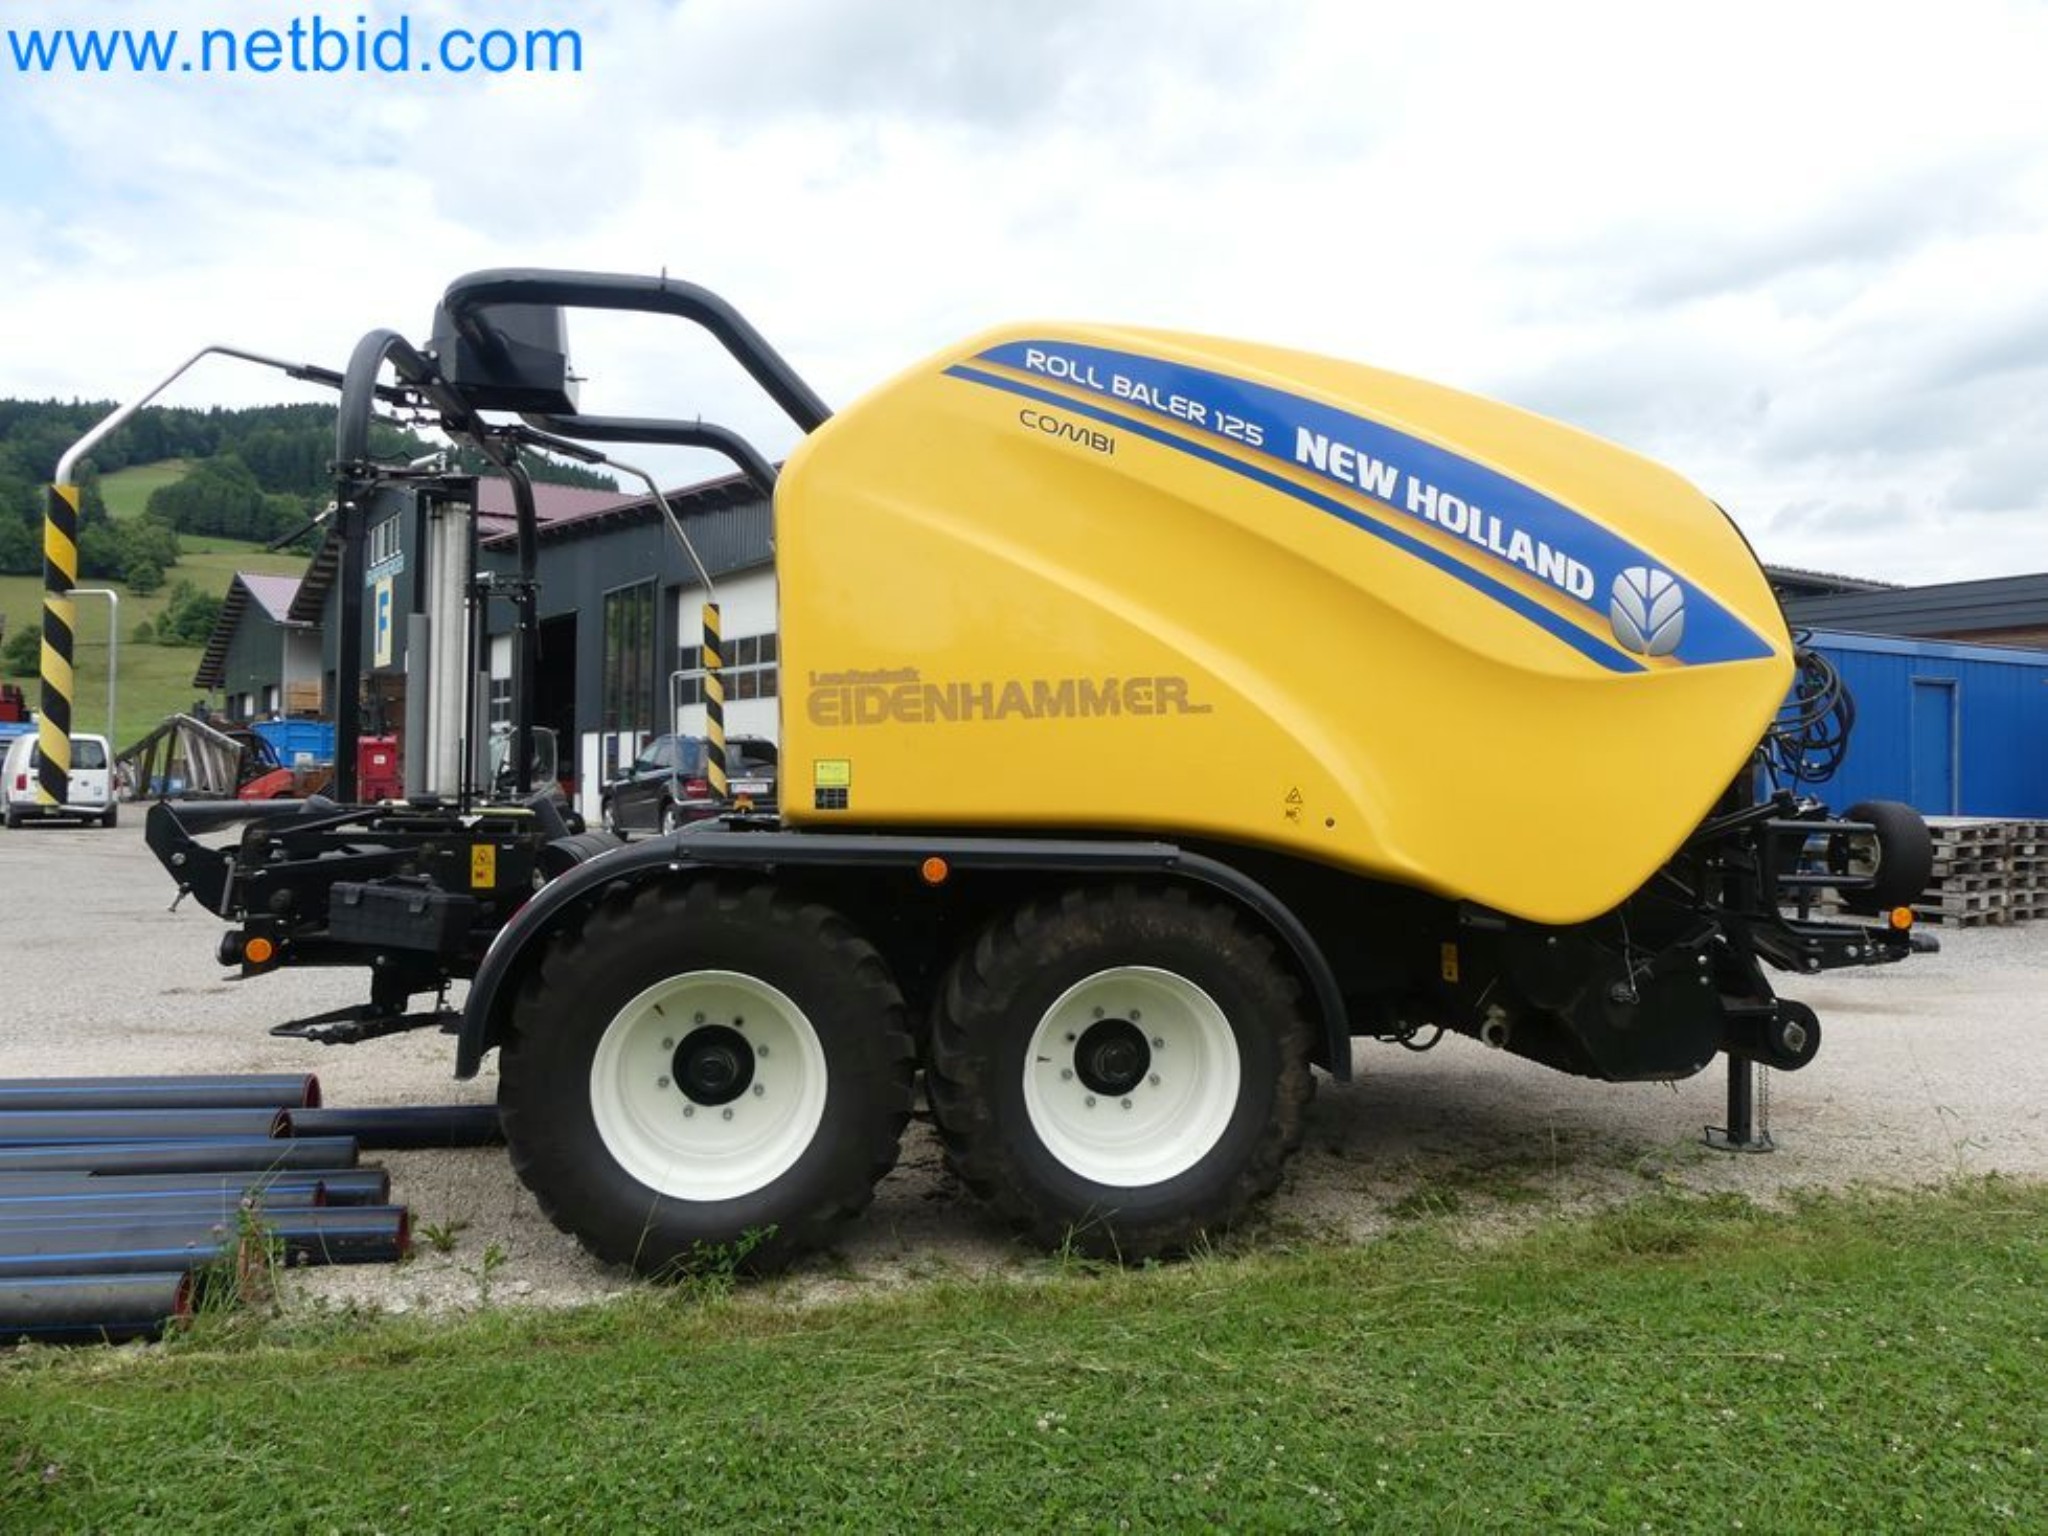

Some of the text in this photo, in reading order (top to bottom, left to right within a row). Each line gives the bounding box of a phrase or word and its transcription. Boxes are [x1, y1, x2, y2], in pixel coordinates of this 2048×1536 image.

[1019, 409, 1115, 455] COMBI
[1025, 348, 1264, 446] ROLL BALER 125
[1296, 427, 1595, 601] NEW HOLLAND
[807, 677, 1190, 727] EIDENHAMMER
